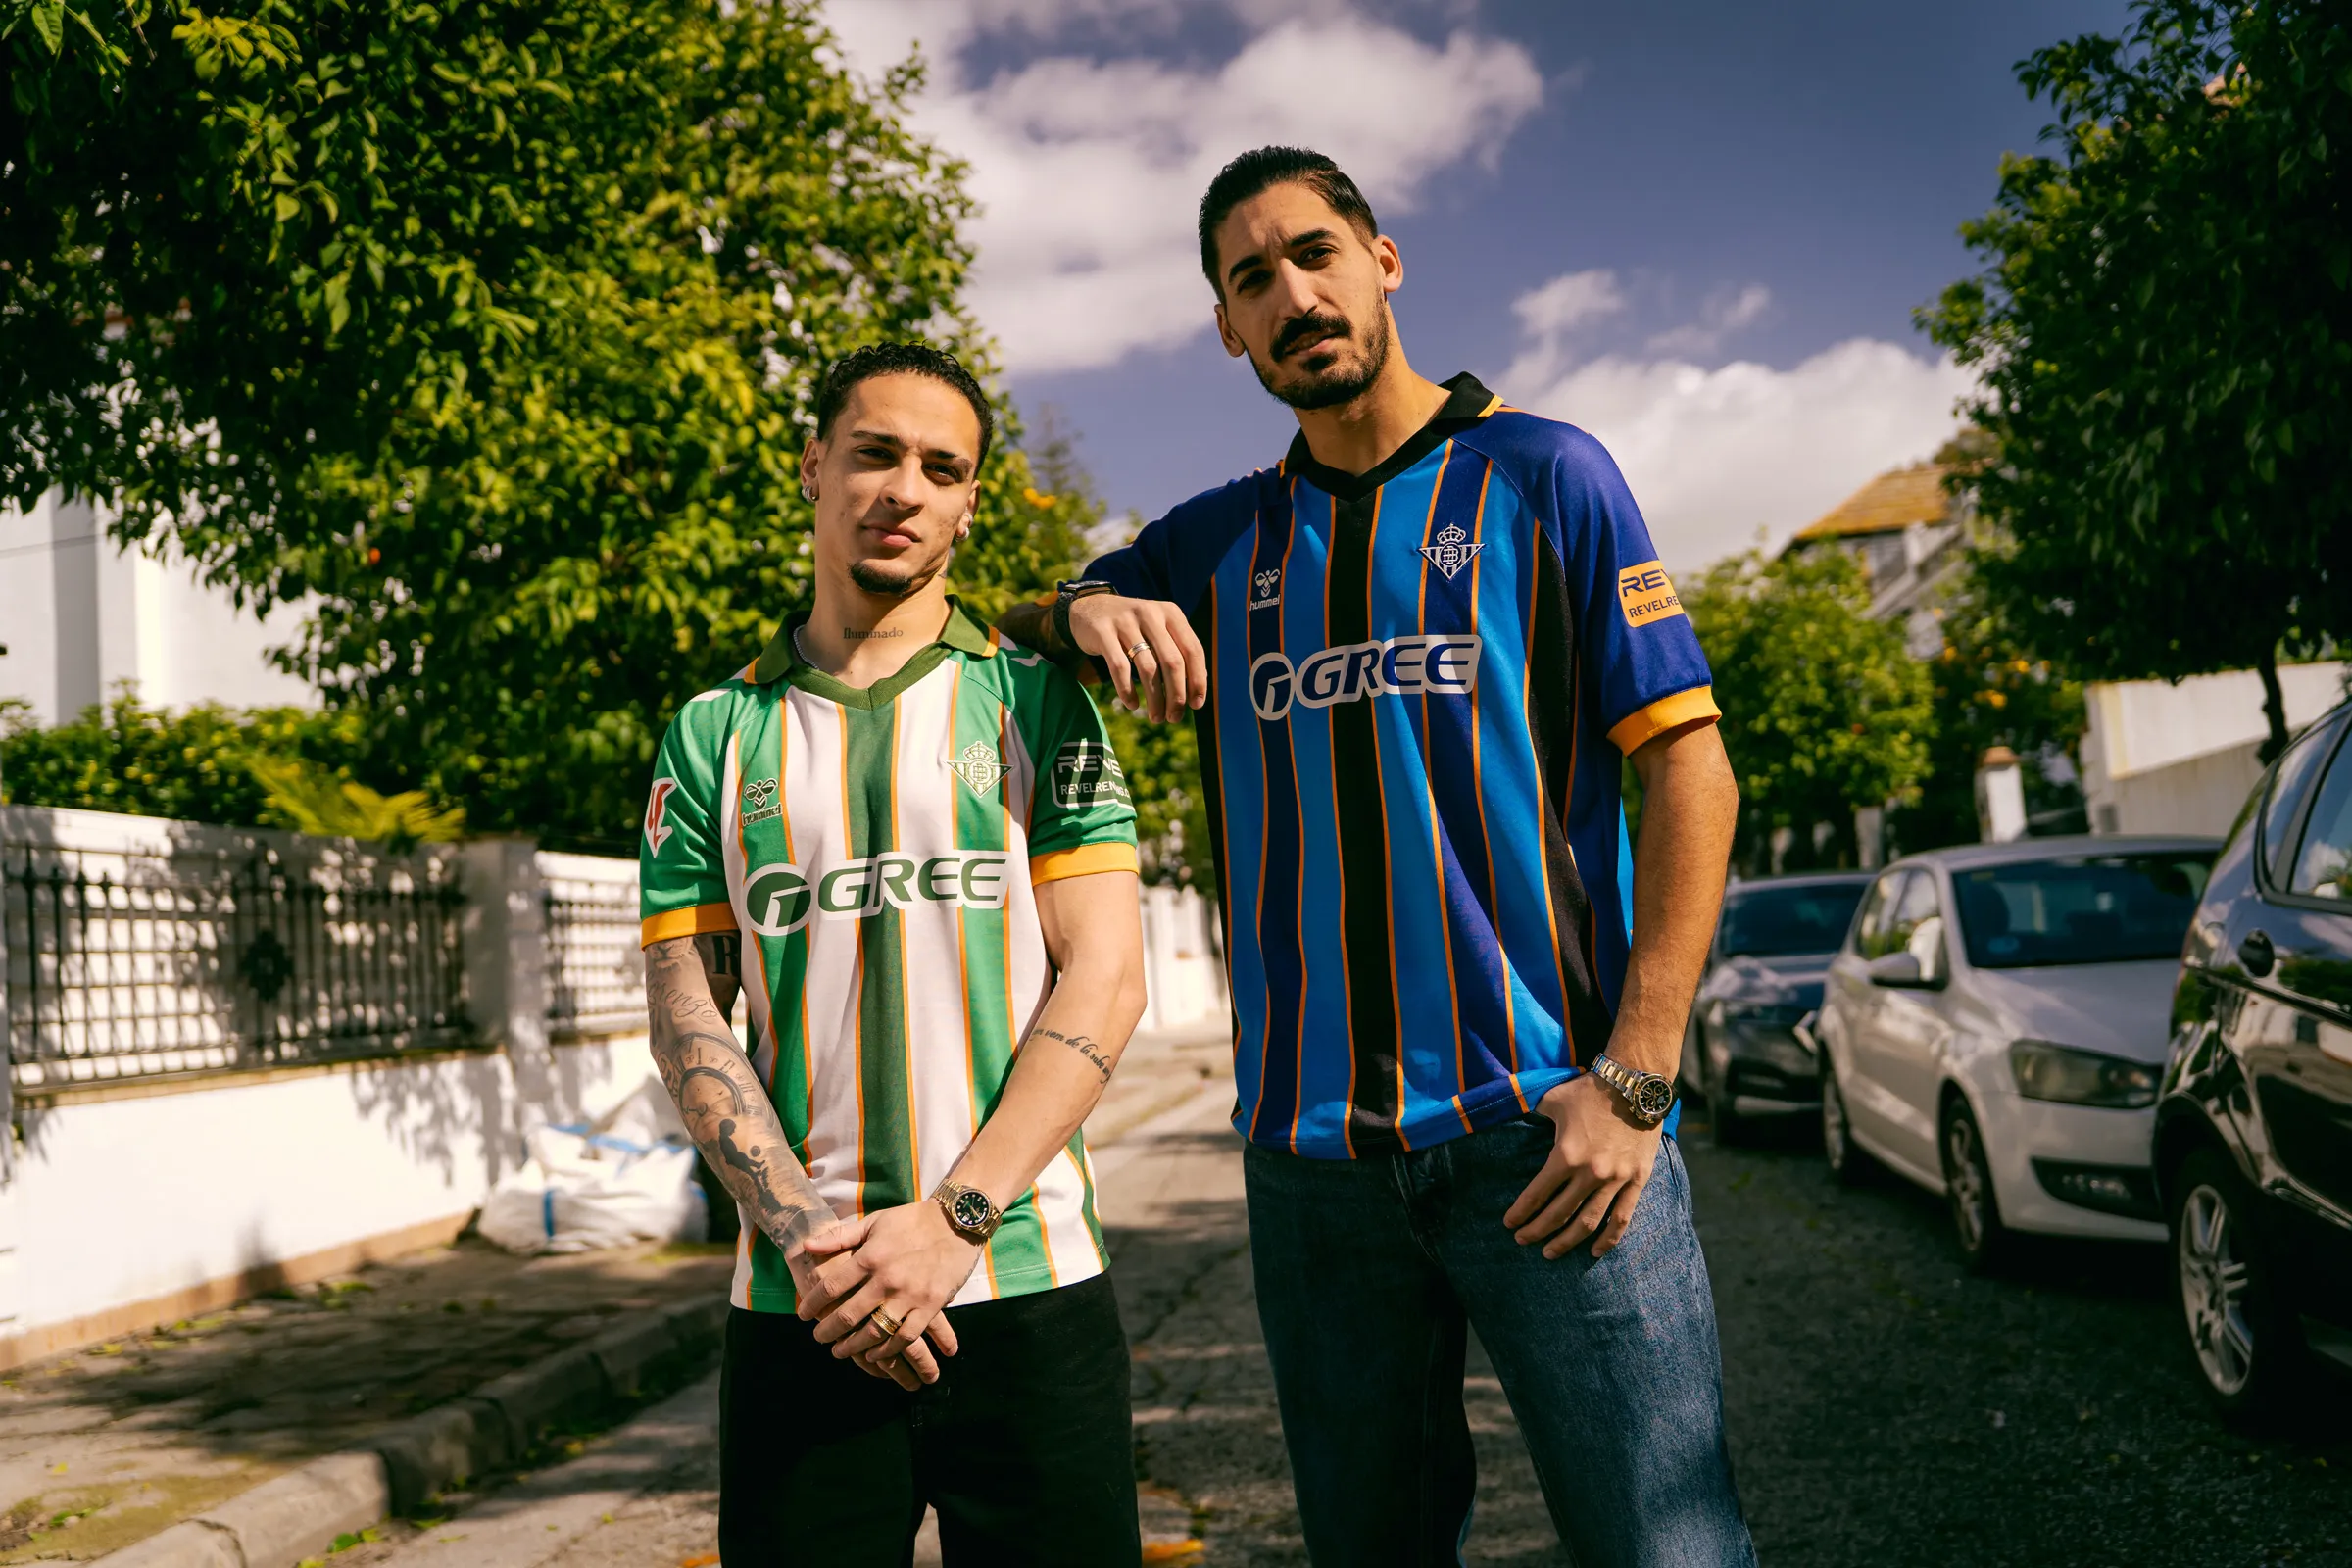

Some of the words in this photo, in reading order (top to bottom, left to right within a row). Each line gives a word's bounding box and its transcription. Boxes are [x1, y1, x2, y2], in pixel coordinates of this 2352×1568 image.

[1620, 568, 1668, 597] RE
[1250, 593, 1281, 612] hummel
[1629, 595, 1680, 617] REVELRE
[843, 626, 904, 639] Iluminado
[1301, 642, 1475, 701] GREE
[817, 857, 1006, 913] GREE
